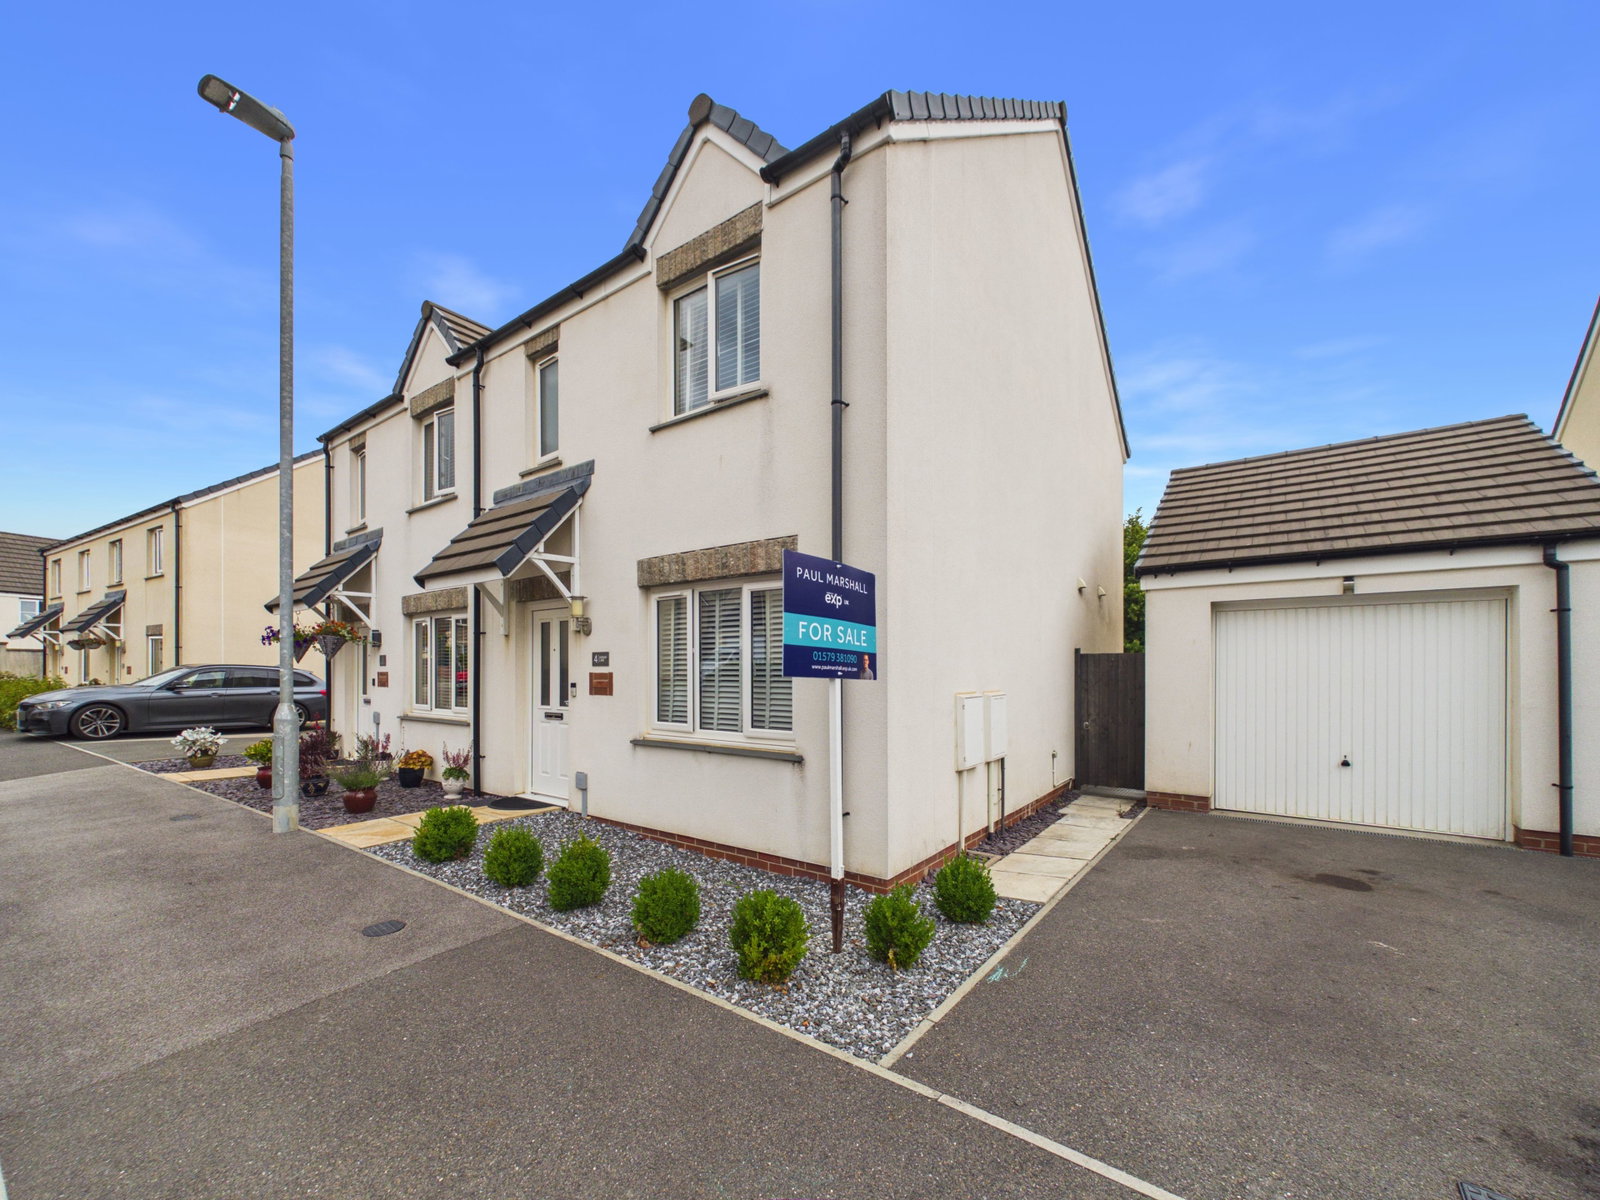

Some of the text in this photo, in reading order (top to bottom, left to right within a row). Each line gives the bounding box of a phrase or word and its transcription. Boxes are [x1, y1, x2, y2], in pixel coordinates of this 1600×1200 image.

[796, 567, 868, 594] PAUL MARSHALL
[798, 621, 868, 647] FOR SALE
[812, 651, 858, 664] 01579 381090
